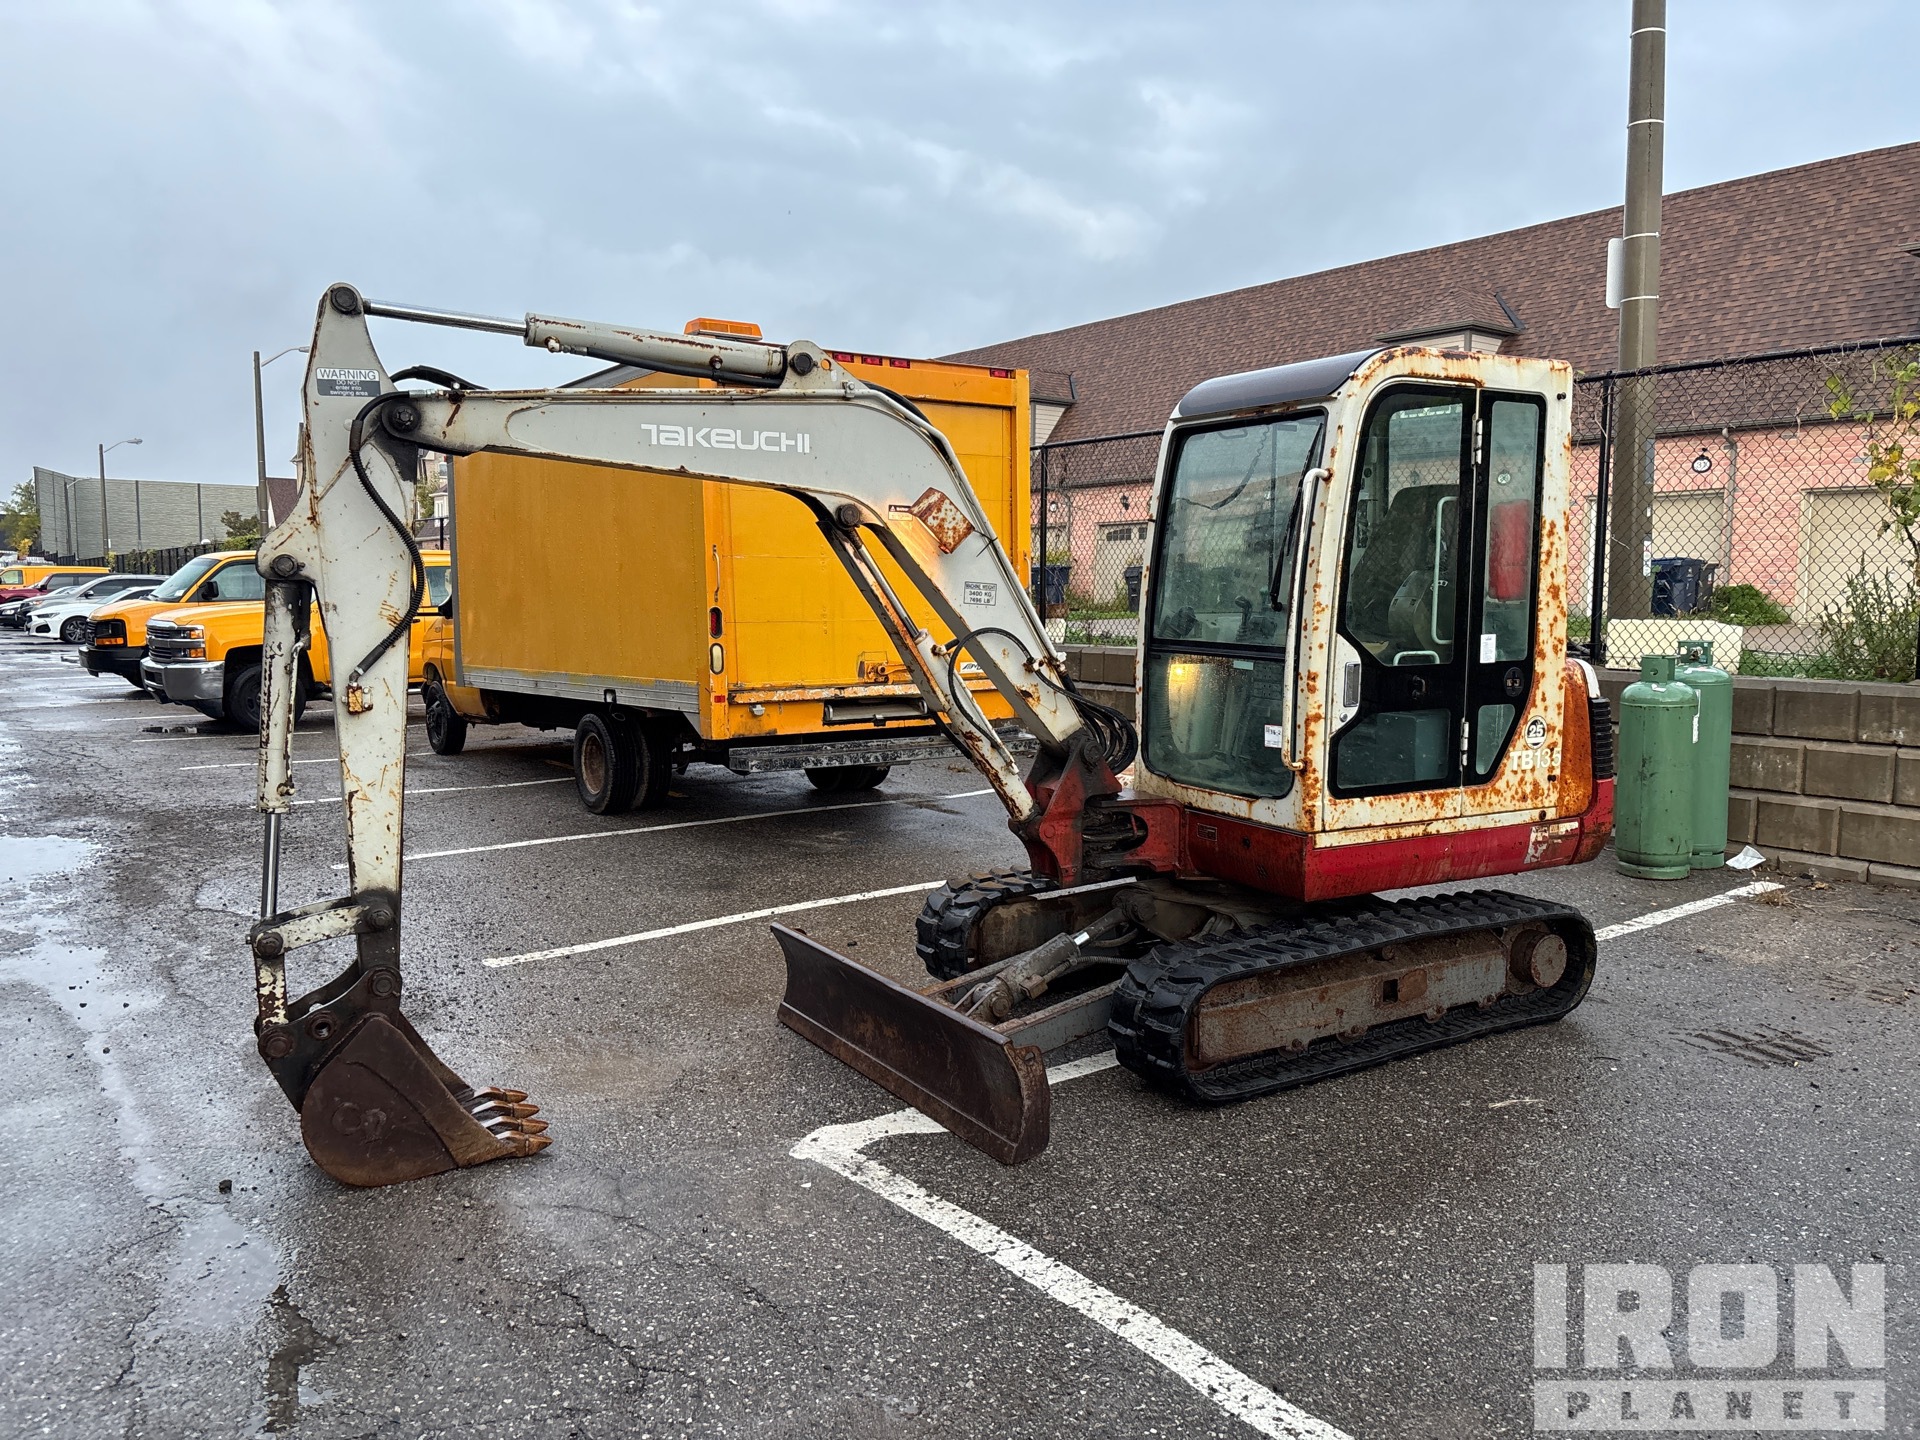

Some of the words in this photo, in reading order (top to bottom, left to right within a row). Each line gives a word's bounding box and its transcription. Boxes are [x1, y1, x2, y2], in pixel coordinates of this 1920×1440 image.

[319, 369, 376, 380] WARNING
[641, 424, 810, 453] TAKEUCHI
[1529, 724, 1544, 738] 25
[1510, 748, 1561, 770] TB135
